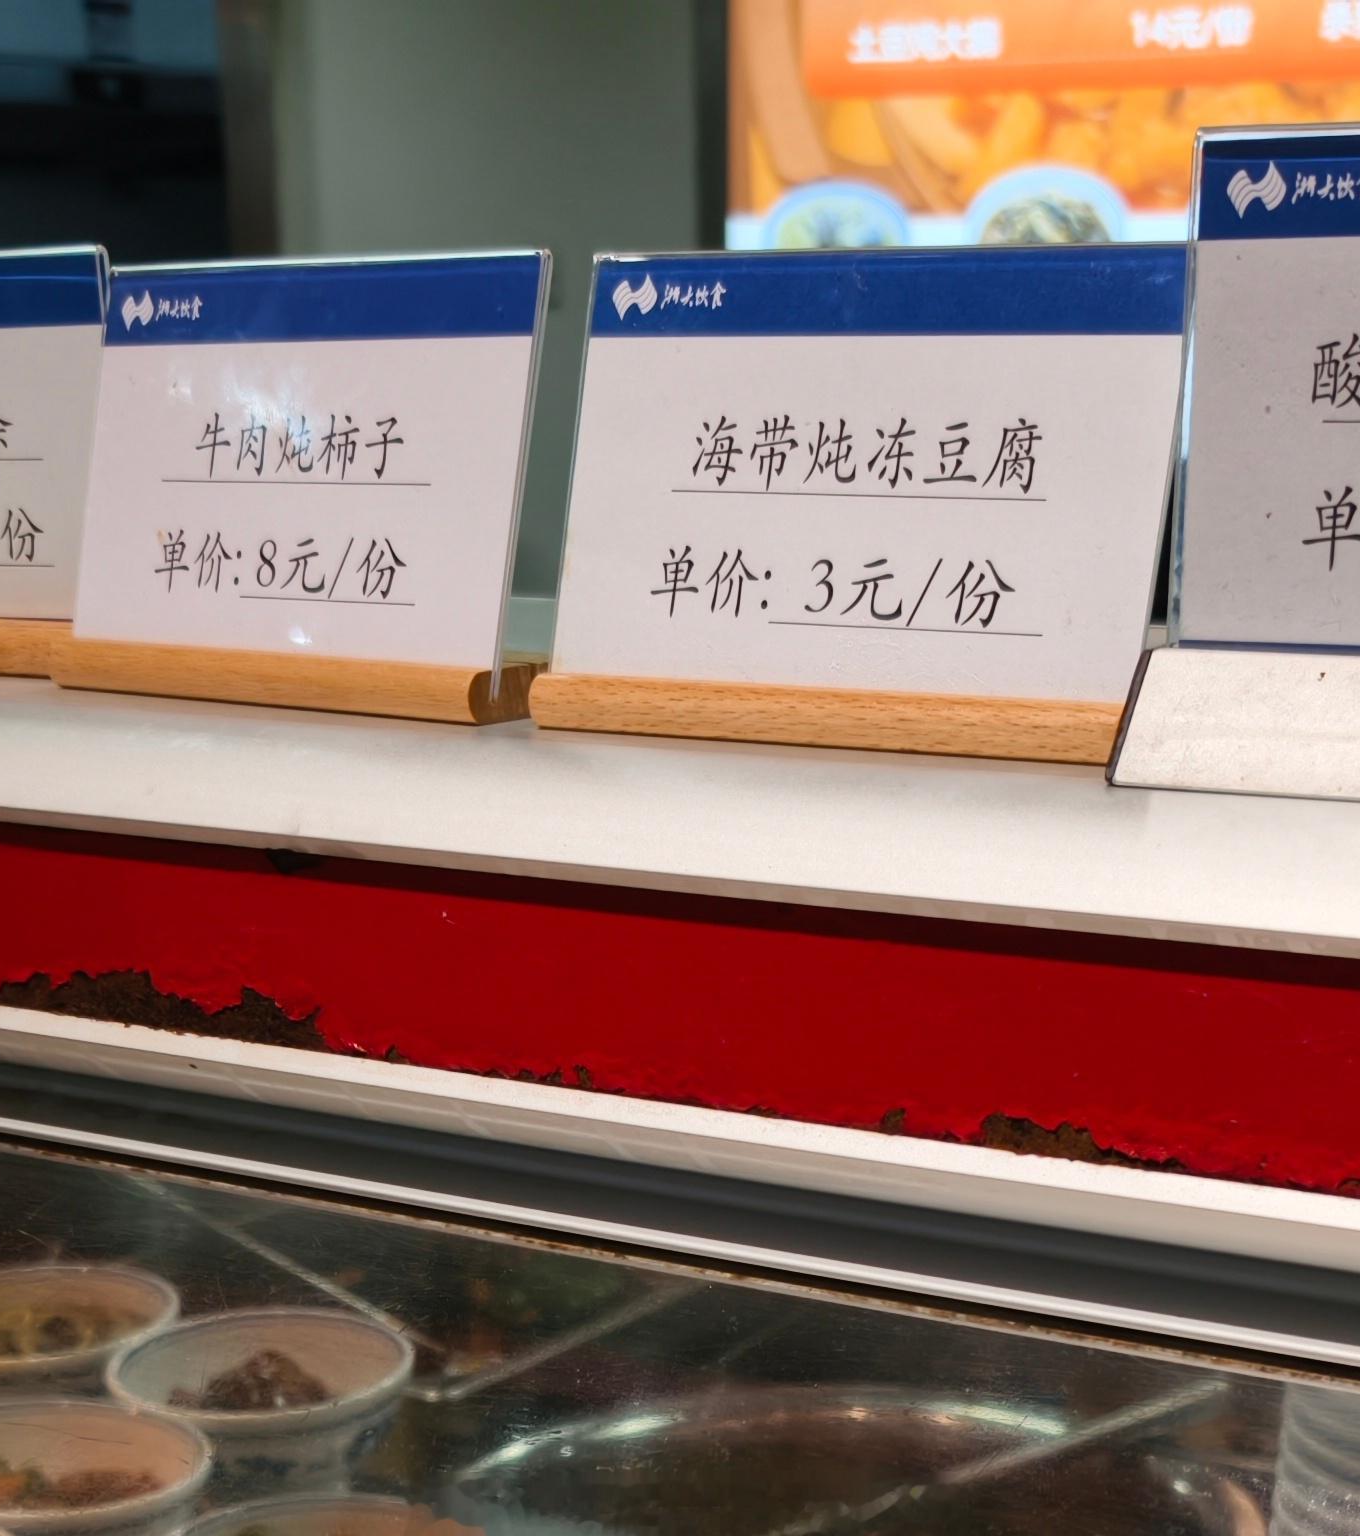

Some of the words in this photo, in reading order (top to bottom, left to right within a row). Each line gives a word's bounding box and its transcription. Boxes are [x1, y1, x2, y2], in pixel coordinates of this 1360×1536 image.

[195, 412, 405, 480] 牛肉炖柿子
[691, 413, 1043, 492] 海带炖冻豆腐
